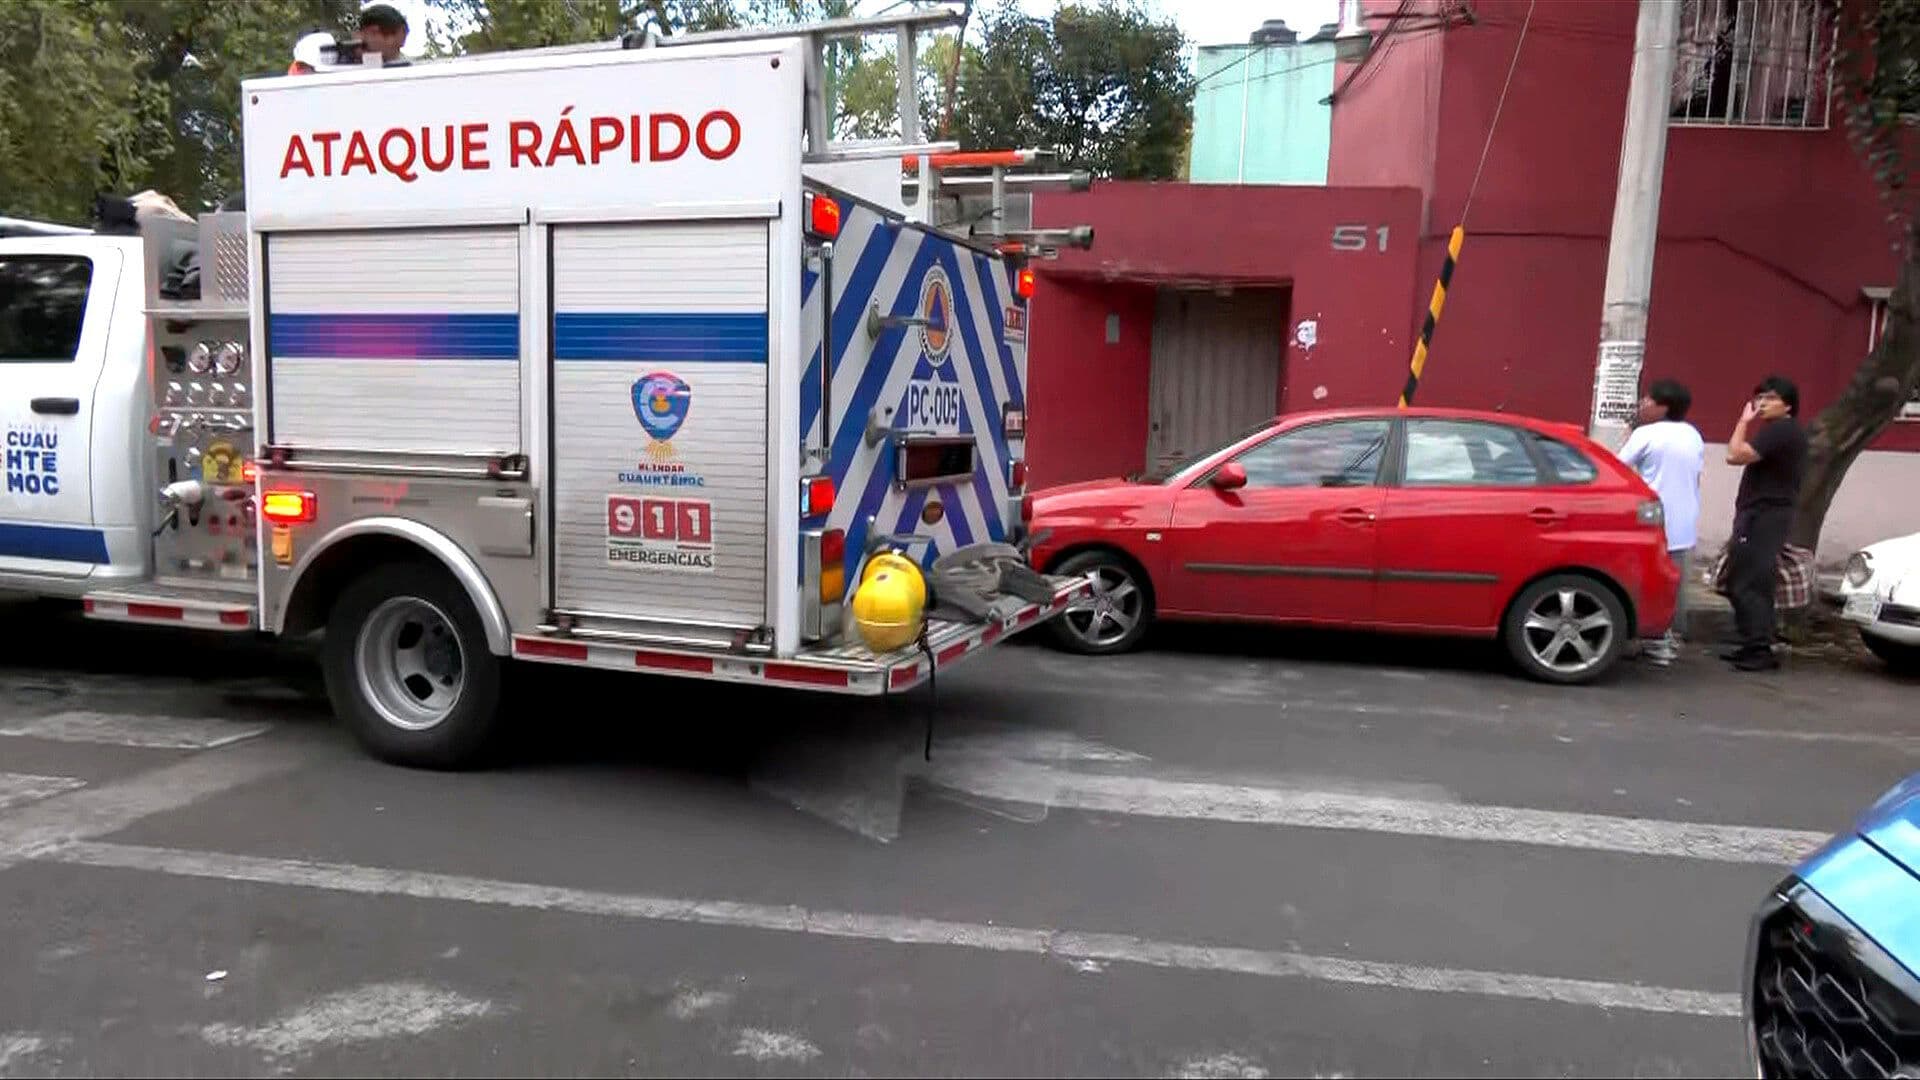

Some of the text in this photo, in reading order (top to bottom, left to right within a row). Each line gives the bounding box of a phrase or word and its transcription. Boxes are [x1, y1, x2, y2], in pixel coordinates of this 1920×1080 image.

[280, 105, 741, 183] ATAQUE RÁPIDO
[1332, 225, 1389, 252] 51
[7, 431, 58, 449] CUAU
[7, 471, 59, 496] MOC
[614, 503, 702, 537] 911
[608, 548, 713, 568] EMERGENCIAS
